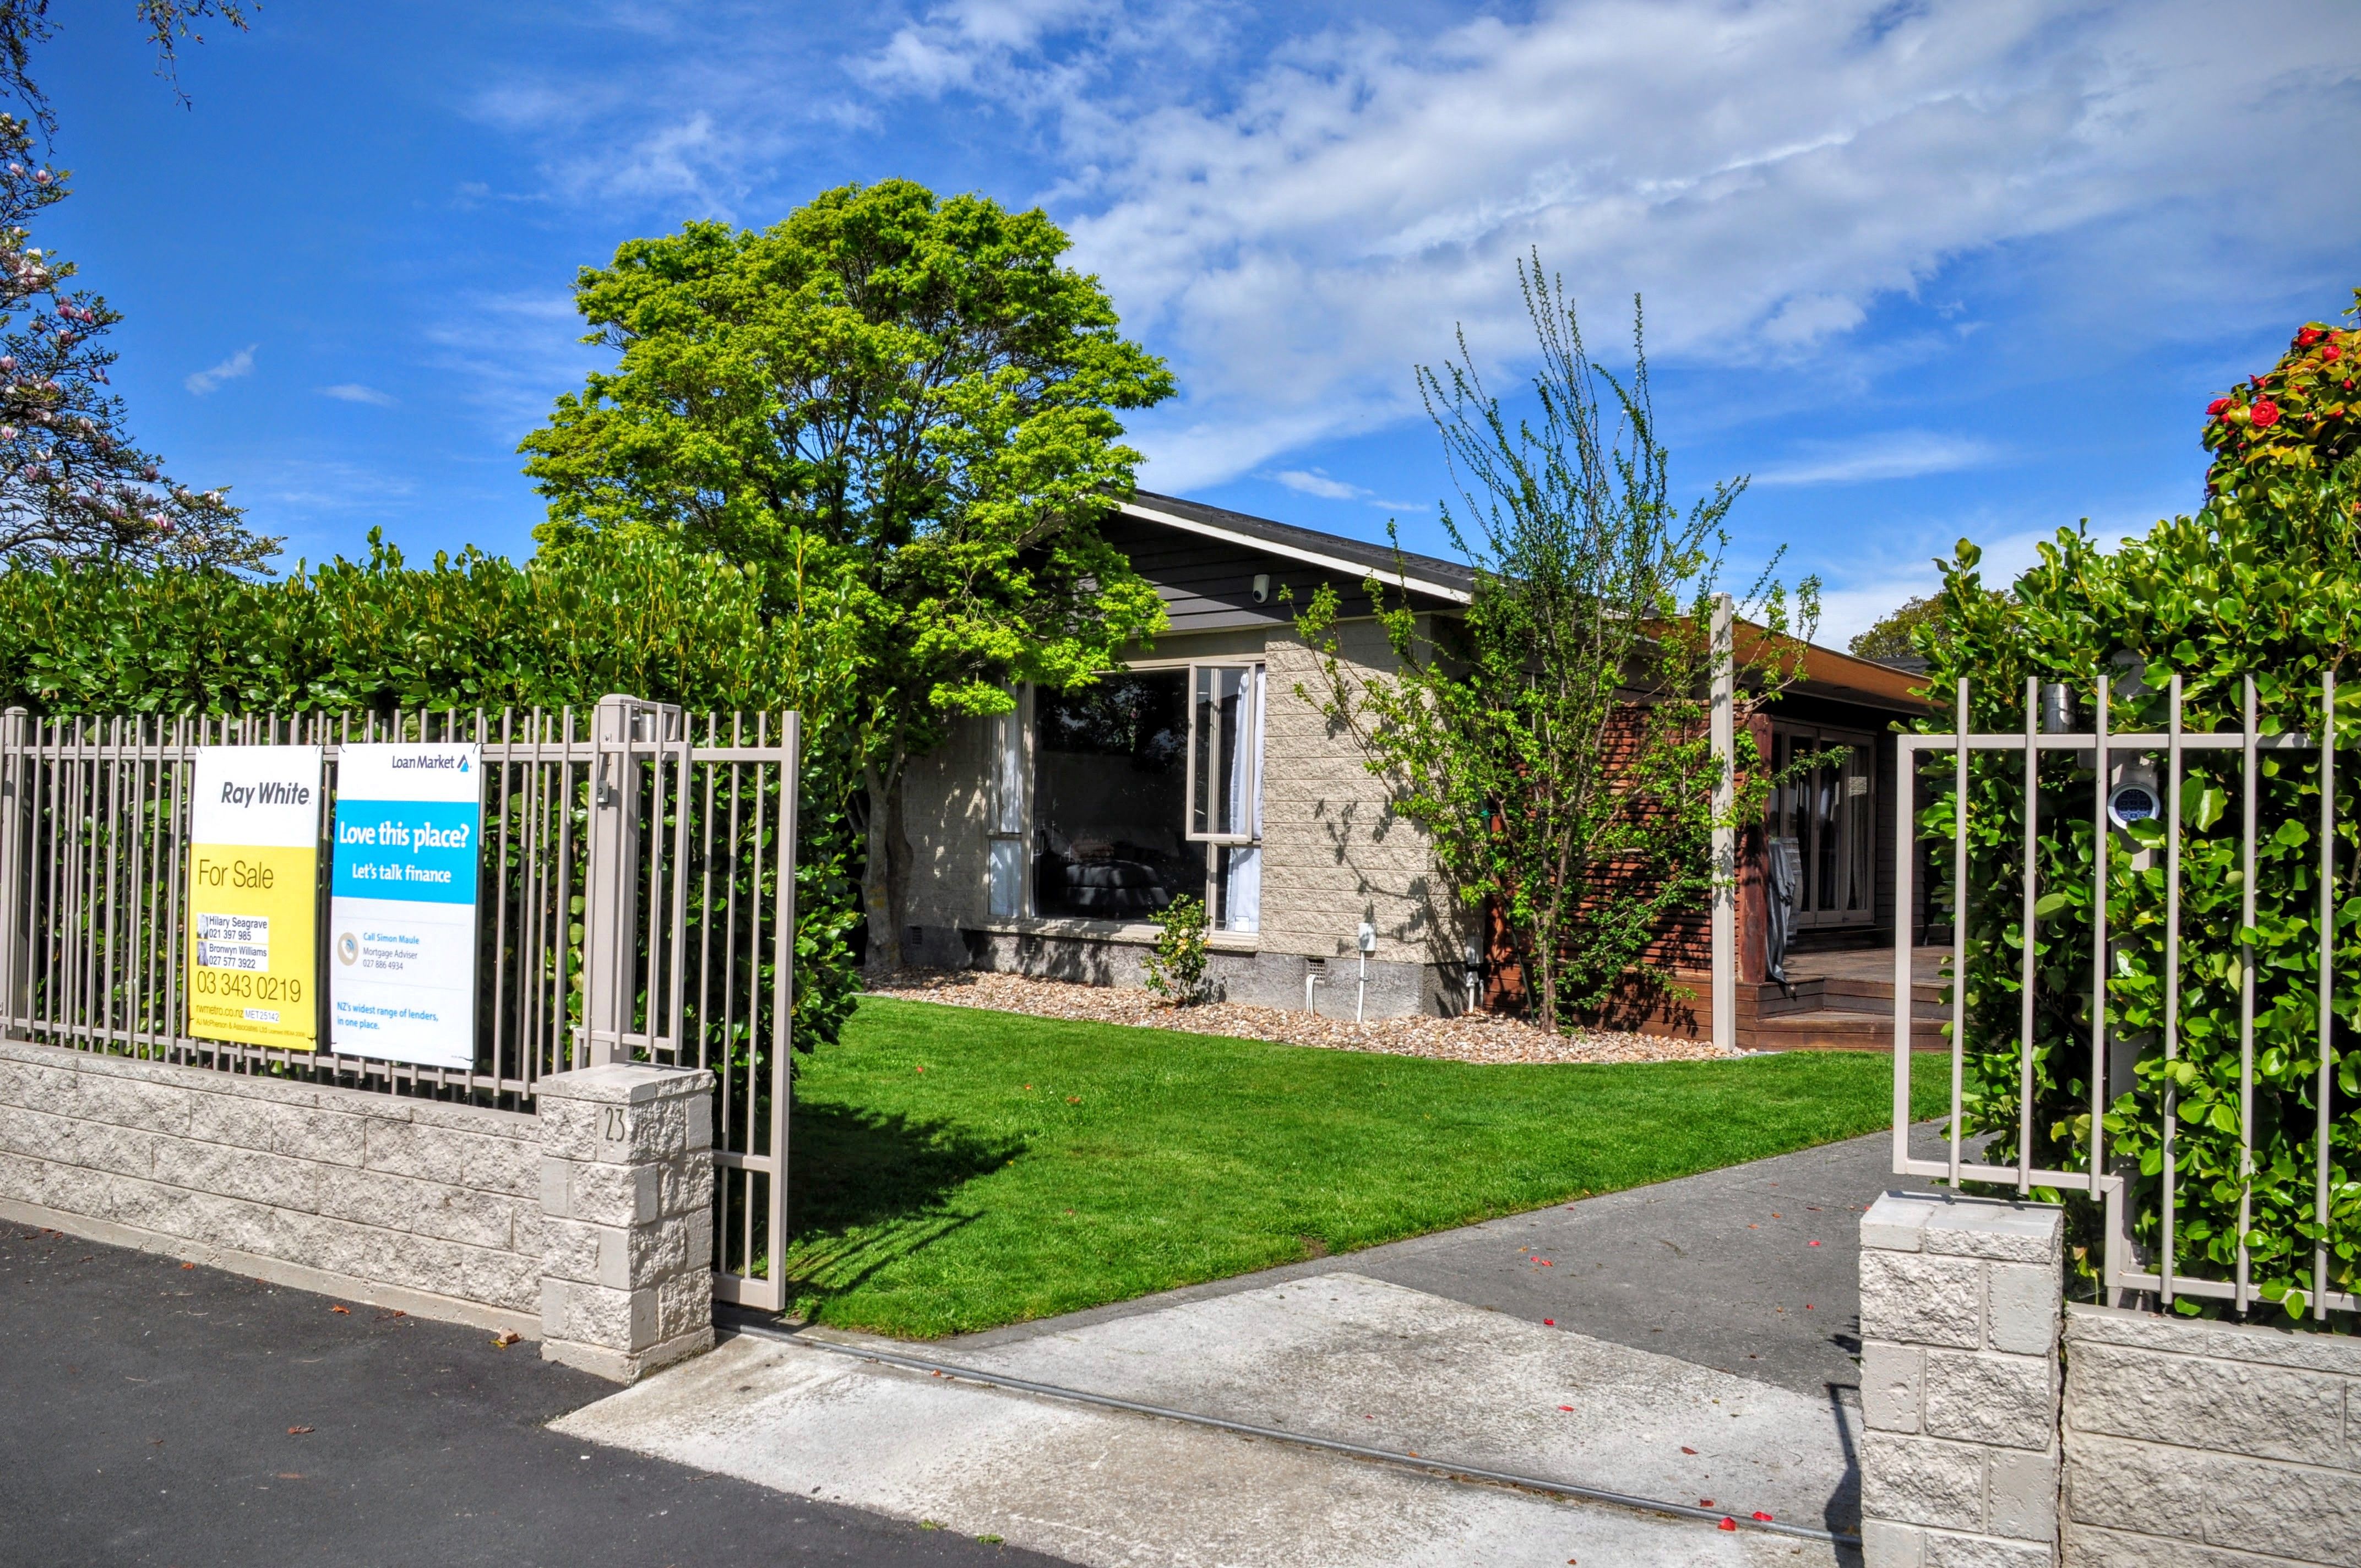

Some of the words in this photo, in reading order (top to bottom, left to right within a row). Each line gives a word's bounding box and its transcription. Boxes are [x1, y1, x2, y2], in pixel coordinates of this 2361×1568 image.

[392, 755, 416, 769] Loan
[417, 754, 455, 769] Market
[221, 782, 255, 808] Ray
[259, 782, 309, 805] White
[339, 821, 376, 845] Love
[378, 820, 410, 846] this
[413, 821, 470, 854] place?
[199, 859, 228, 886] For
[233, 860, 274, 889] Sale
[352, 863, 377, 879] Let's
[379, 864, 402, 880] talk
[405, 864, 451, 883] finance
[209, 916, 230, 929] Hilary
[232, 917, 268, 930] Seagrave
[209, 929, 220, 938] 021
[224, 929, 236, 940] 397
[238, 930, 252, 941] 985
[363, 932, 375, 941] Call
[377, 934, 397, 943] Simon
[399, 935, 419, 944] Maule
[209, 943, 237, 956] Bronwyn
[238, 945, 267, 957] Williams
[363, 947, 393, 959] Mortgage
[394, 950, 417, 959] Adviser
[209, 955, 221, 965] 027
[224, 957, 236, 967] 577
[238, 958, 255, 968] 3922
[363, 959, 374, 968] 027
[197, 971, 216, 994] 03
[221, 973, 252, 998] 343
[257, 977, 301, 1003] 0219
[196, 1004, 243, 1019] rwmetro.co.nz
[337, 1001, 351, 1011] NZ's
[352, 1004, 375, 1014] widest
[377, 1008, 398, 1019] range
[399, 1009, 407, 1017] of
[409, 1009, 439, 1022] lenders,
[337, 1016, 344, 1025] in
[345, 1019, 358, 1027] one
[360, 1019, 380, 1030] place.
[605, 1106, 625, 1142] 23
